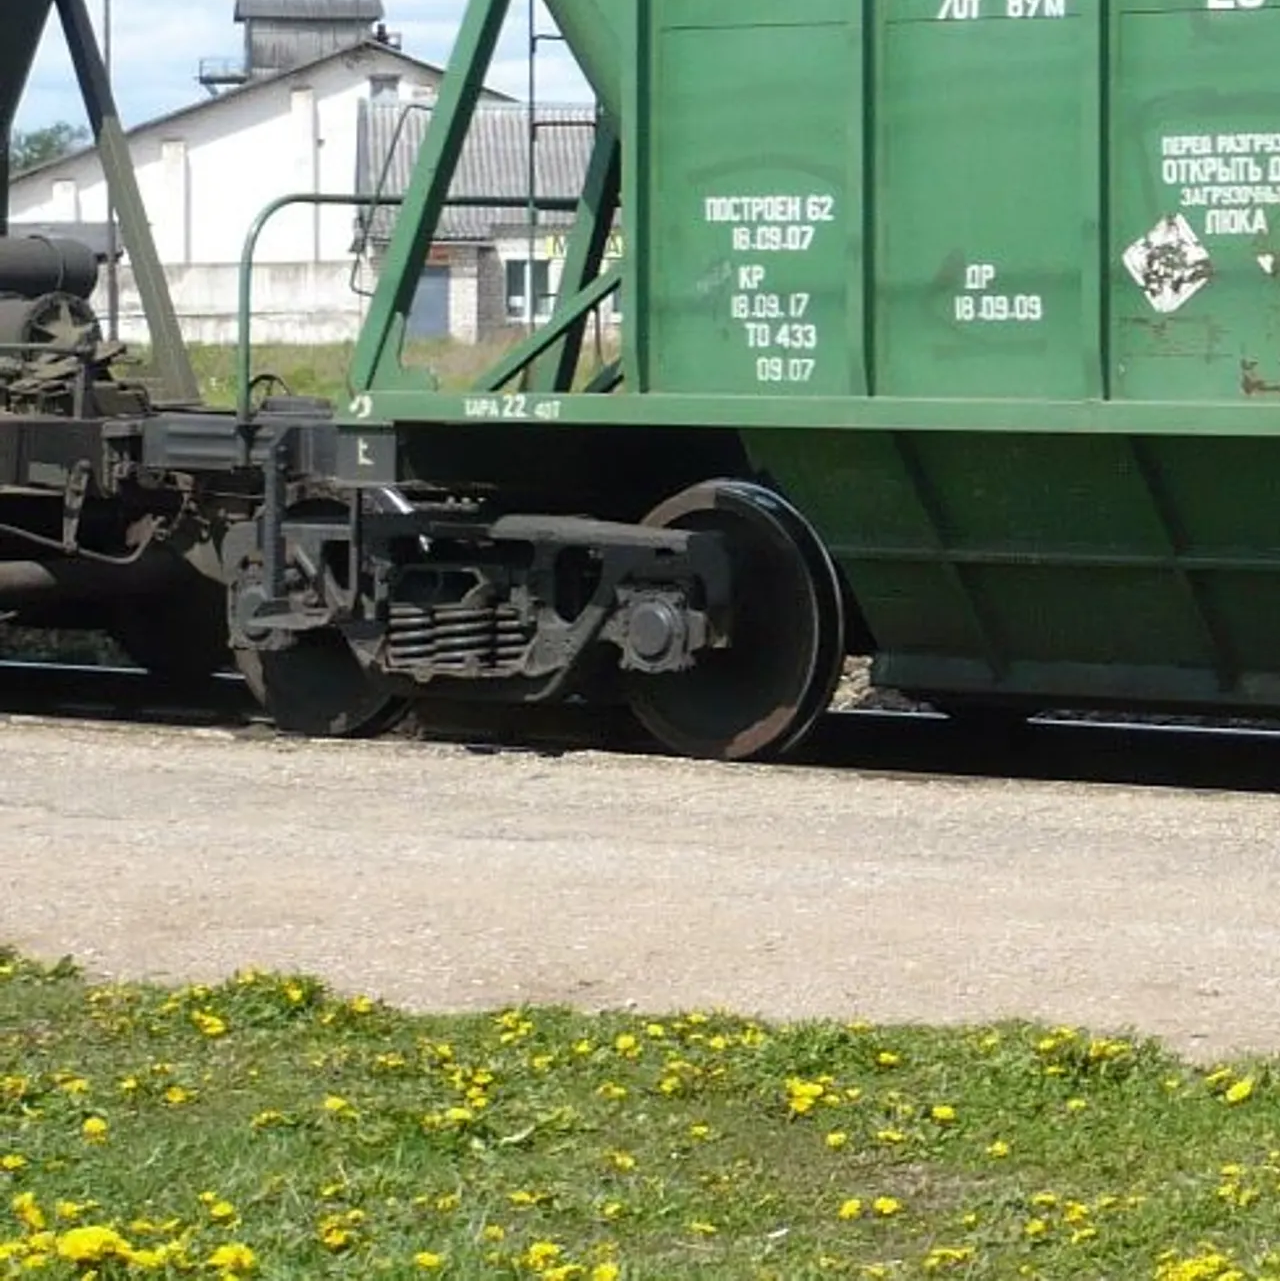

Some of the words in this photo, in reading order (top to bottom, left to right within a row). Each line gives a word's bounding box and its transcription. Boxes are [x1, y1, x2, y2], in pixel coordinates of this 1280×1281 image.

[1161, 135, 1213, 156] ПЕРЕД
[1162, 156, 1263, 184] ОТКРЫТЬ
[706, 195, 801, 222] ПОСТРОЕН
[805, 195, 835, 221] 62
[1205, 207, 1269, 235] ЛЮКА
[739, 265, 766, 290] КР
[965, 265, 995, 289] ДР
[955, 295, 1042, 321] 18.09.09
[775, 323, 817, 349] 433
[502, 394, 527, 418] 22
